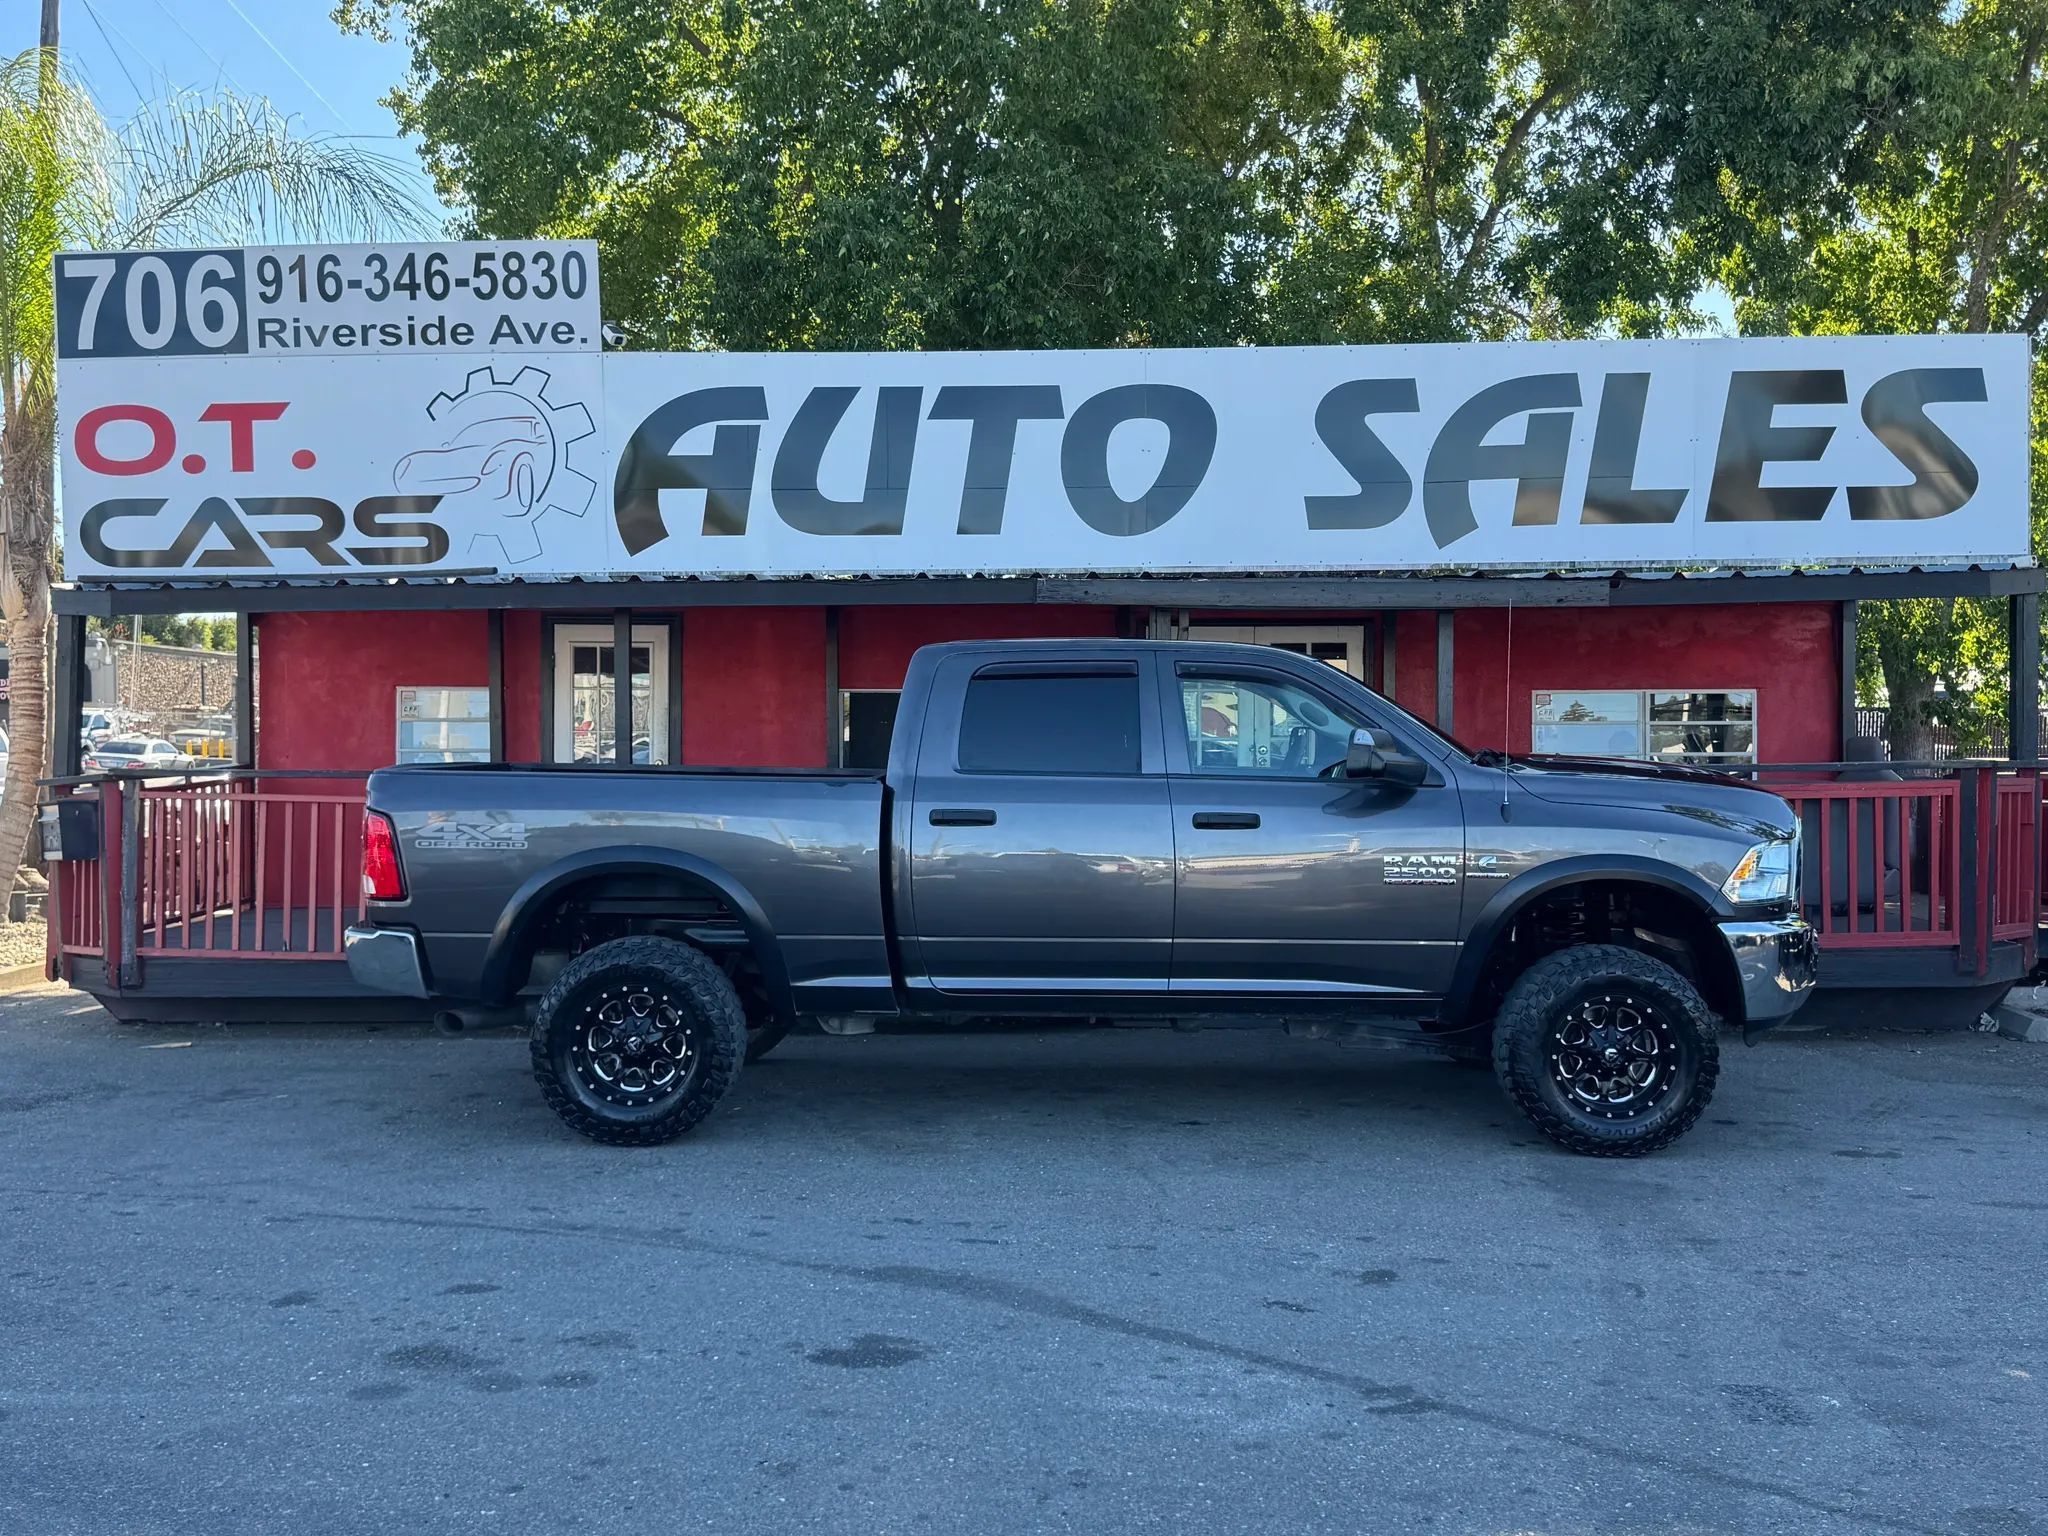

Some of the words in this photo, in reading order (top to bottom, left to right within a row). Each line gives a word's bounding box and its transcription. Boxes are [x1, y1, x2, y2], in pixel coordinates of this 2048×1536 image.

[63, 254, 240, 350] 706
[257, 251, 587, 303] 916-346-5830
[257, 315, 475, 349] Riverside
[488, 314, 588, 345] Ave.
[74, 402, 317, 476] O.T.
[613, 383, 1218, 557] AUTO
[1303, 367, 1989, 550] SALES
[80, 495, 450, 568] CARS
[1383, 855, 1457, 866] RAM
[1383, 867, 1457, 878] 2500
